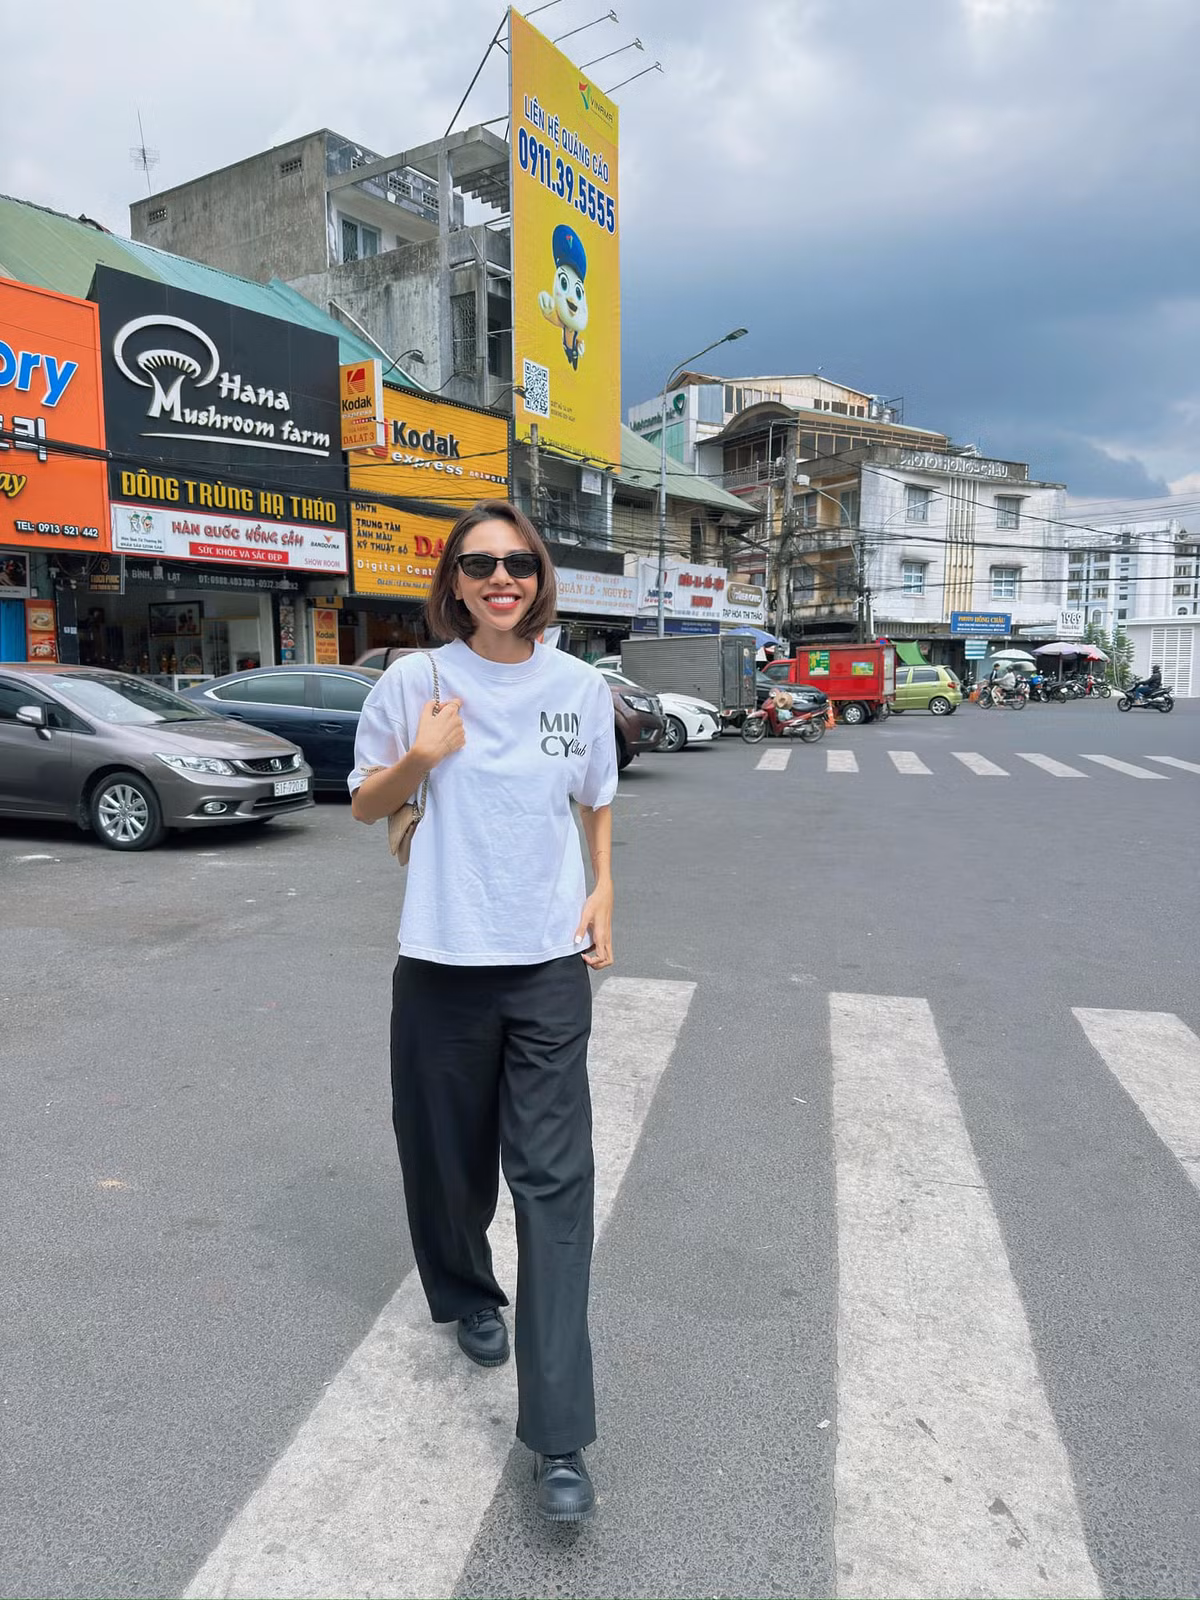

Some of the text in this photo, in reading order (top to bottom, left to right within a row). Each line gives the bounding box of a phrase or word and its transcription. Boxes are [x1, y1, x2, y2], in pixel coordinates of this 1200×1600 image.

[524, 95, 545, 131] LIÊN
[547, 116, 560, 150] HỆ
[518, 127, 615, 233] 0911.39.5555
[219, 372, 290, 411] Hana
[341, 395, 373, 412] Kodak
[147, 375, 331, 447] Mushroom farm
[392, 420, 460, 458] Kodak
[391, 451, 464, 475] express
[121, 468, 180, 501] ĐÔNG
[184, 481, 254, 512] TRÙNG
[259, 491, 284, 519] HẠ
[15, 520, 99, 538] TEL: 0913 521 442
[356, 518, 382, 529] TRUNG
[357, 559, 401, 573] Digital
[1061, 611, 1081, 625] 1989
[540, 711, 581, 736] MIN
[541, 735, 574, 758] CY
